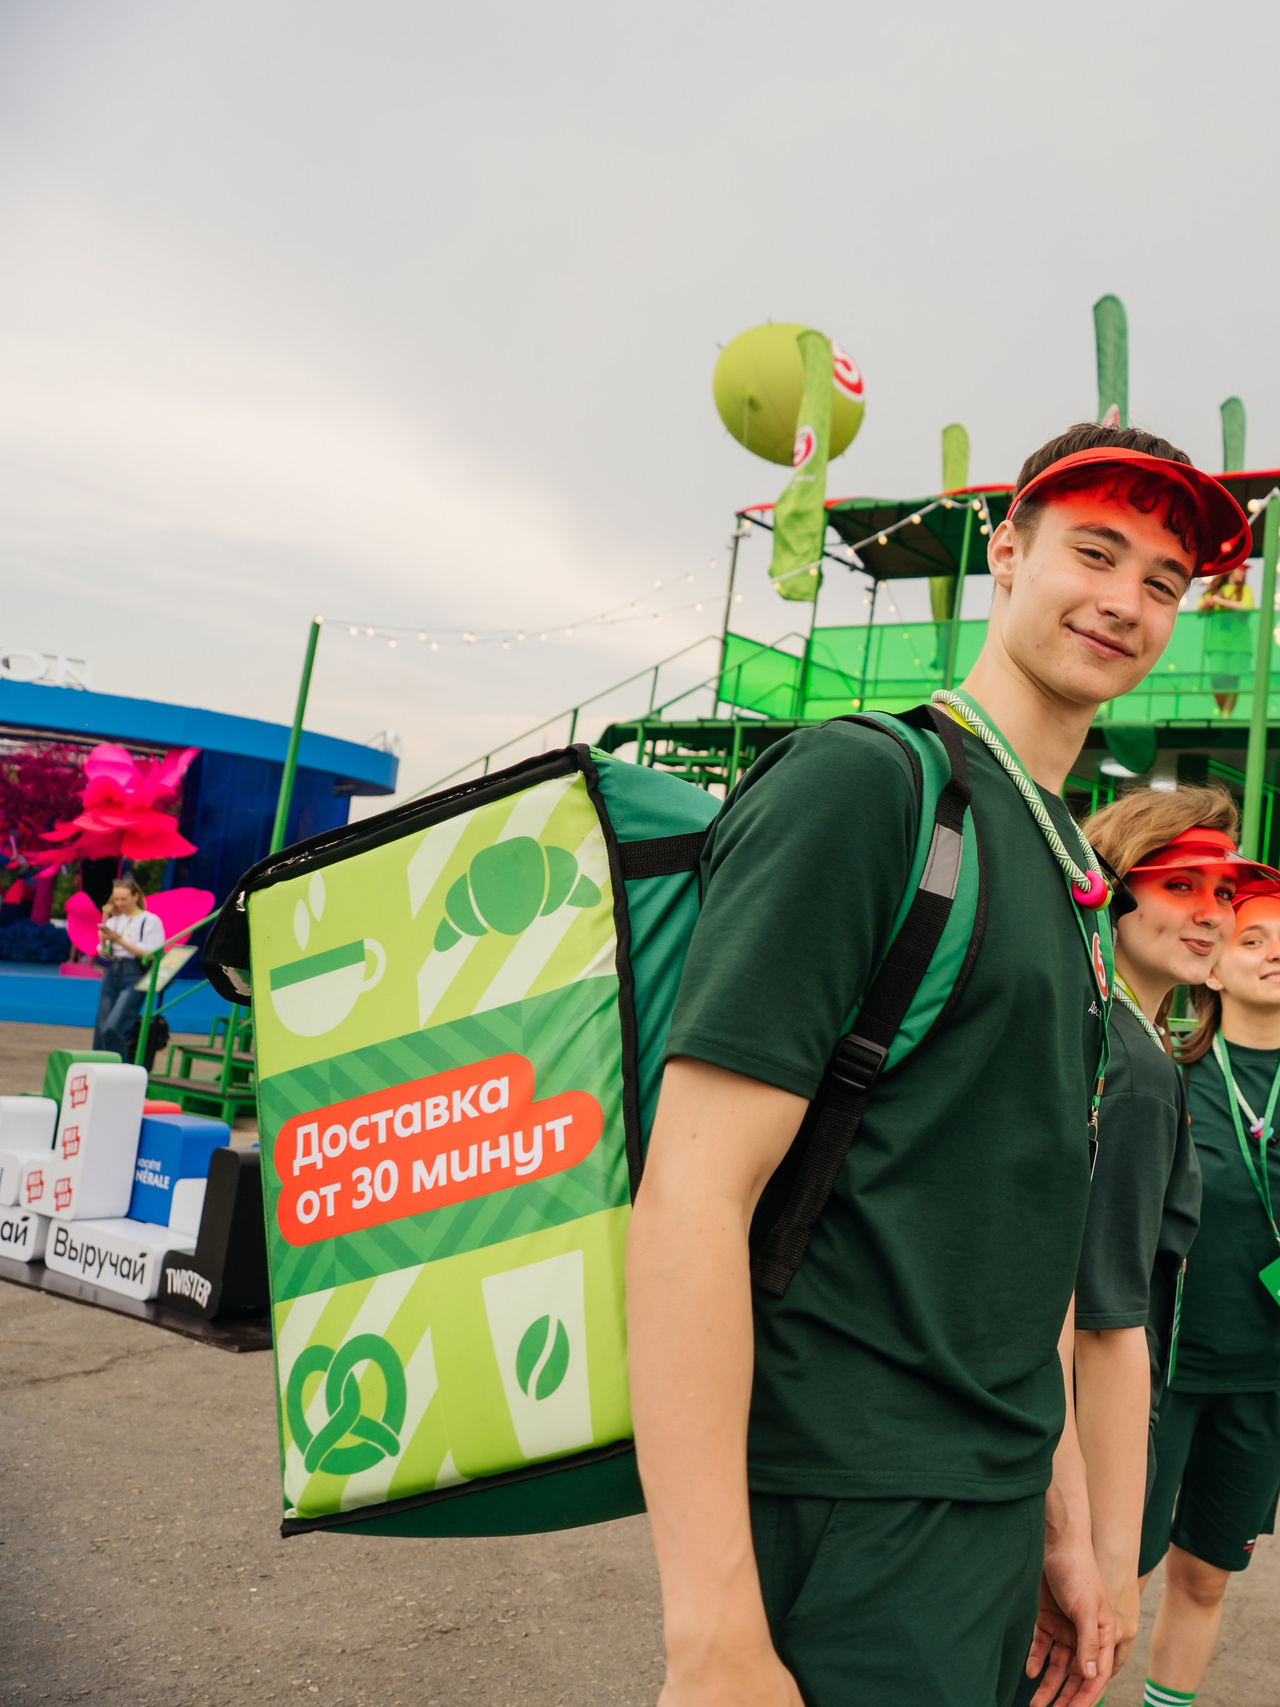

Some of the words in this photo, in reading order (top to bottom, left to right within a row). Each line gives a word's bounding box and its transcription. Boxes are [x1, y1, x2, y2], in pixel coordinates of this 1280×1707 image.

[292, 1076, 510, 1176] Доставка
[295, 1183, 342, 1225] от
[351, 1159, 399, 1210] 30
[412, 1115, 573, 1194] минут
[53, 1226, 148, 1285] Выручай
[165, 1267, 212, 1309] TWISTER
